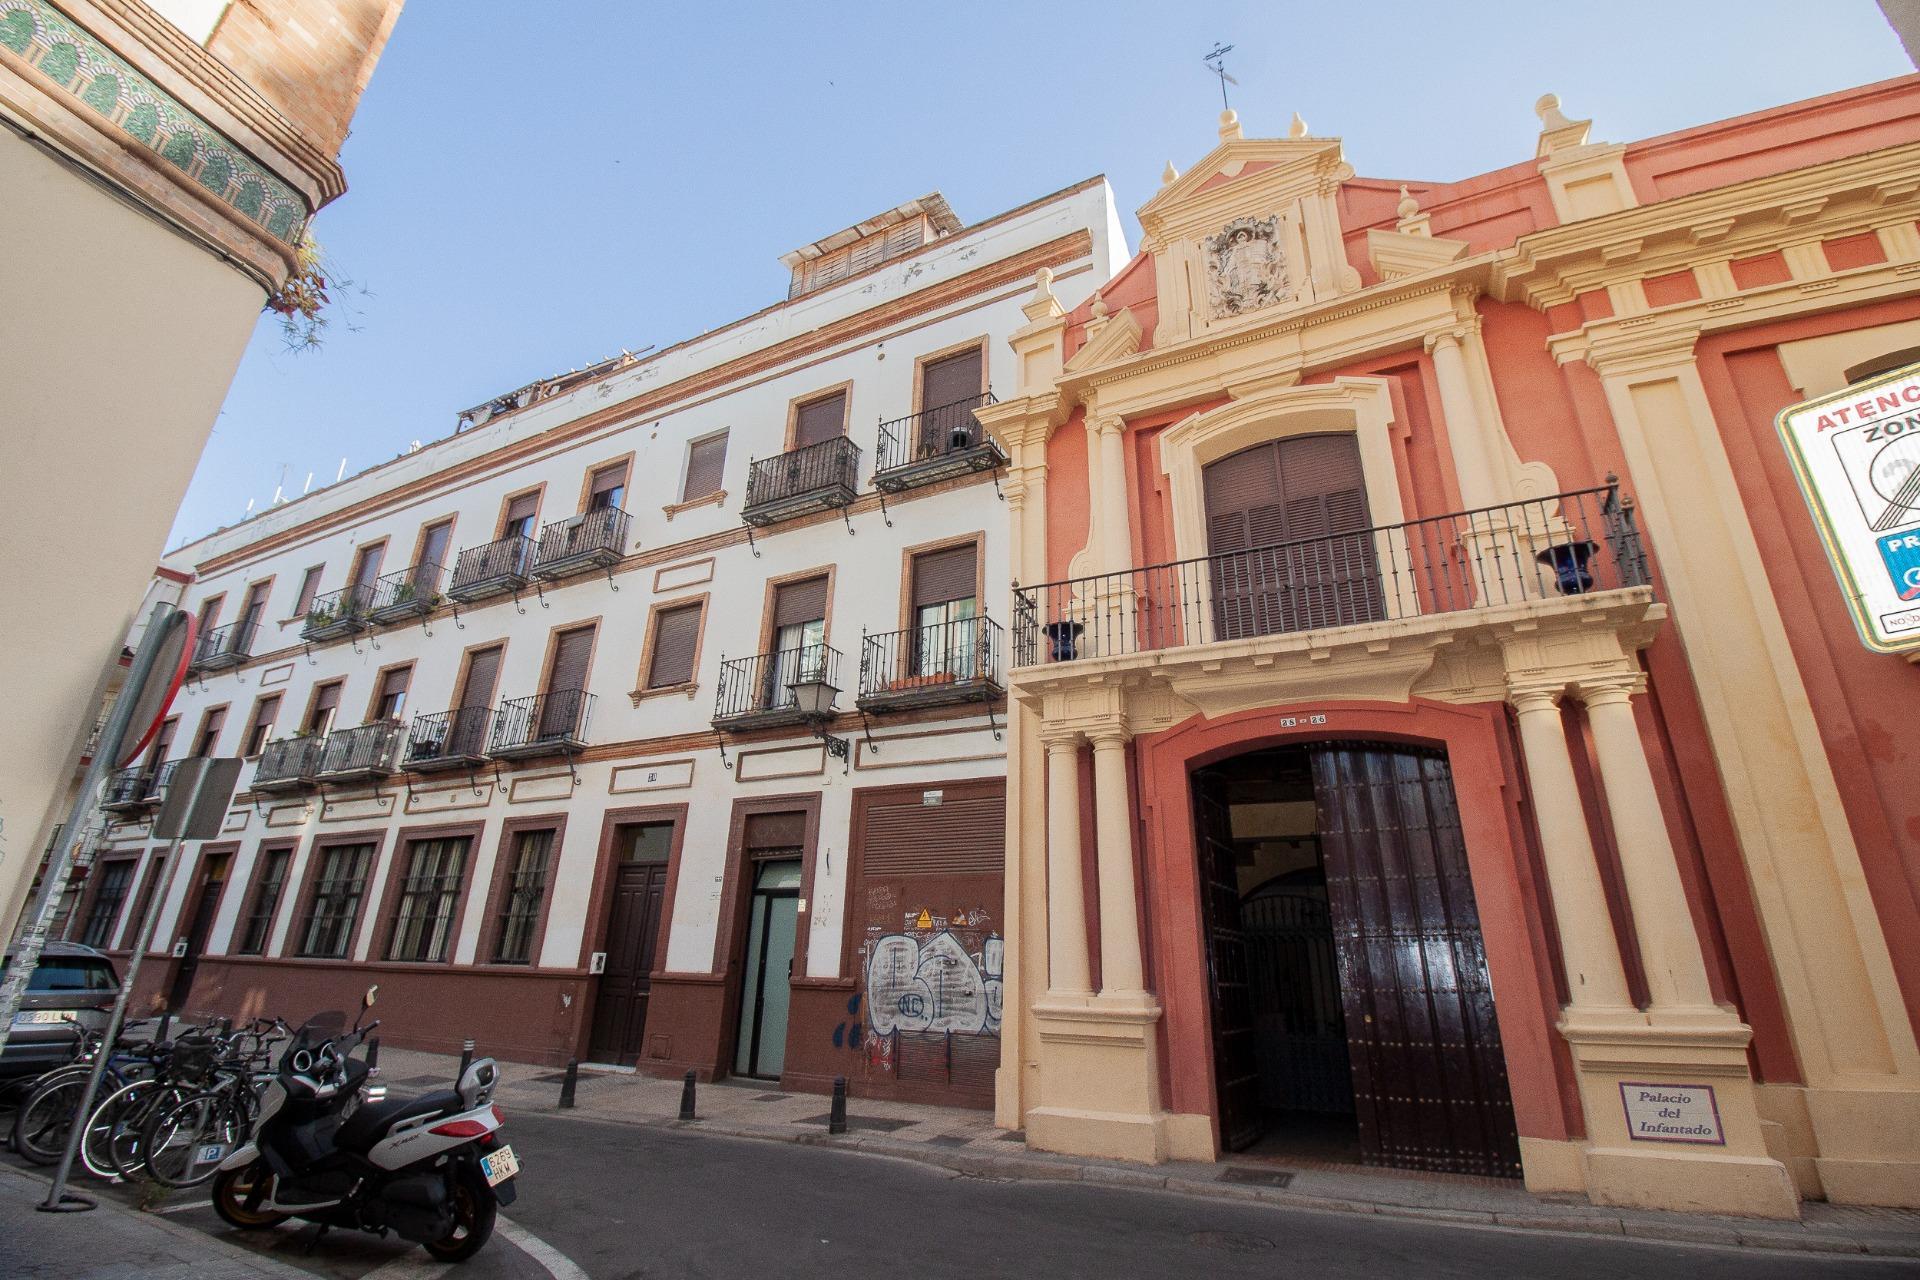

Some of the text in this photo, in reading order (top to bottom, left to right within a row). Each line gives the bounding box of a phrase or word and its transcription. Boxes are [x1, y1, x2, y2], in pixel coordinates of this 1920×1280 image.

[1640, 1091, 1692, 1104] Palacio
[1659, 1107, 1681, 1119] del
[1640, 1121, 1712, 1135] Infantado
[489, 1149, 511, 1167] 6269
[494, 1162, 511, 1180] HKM
